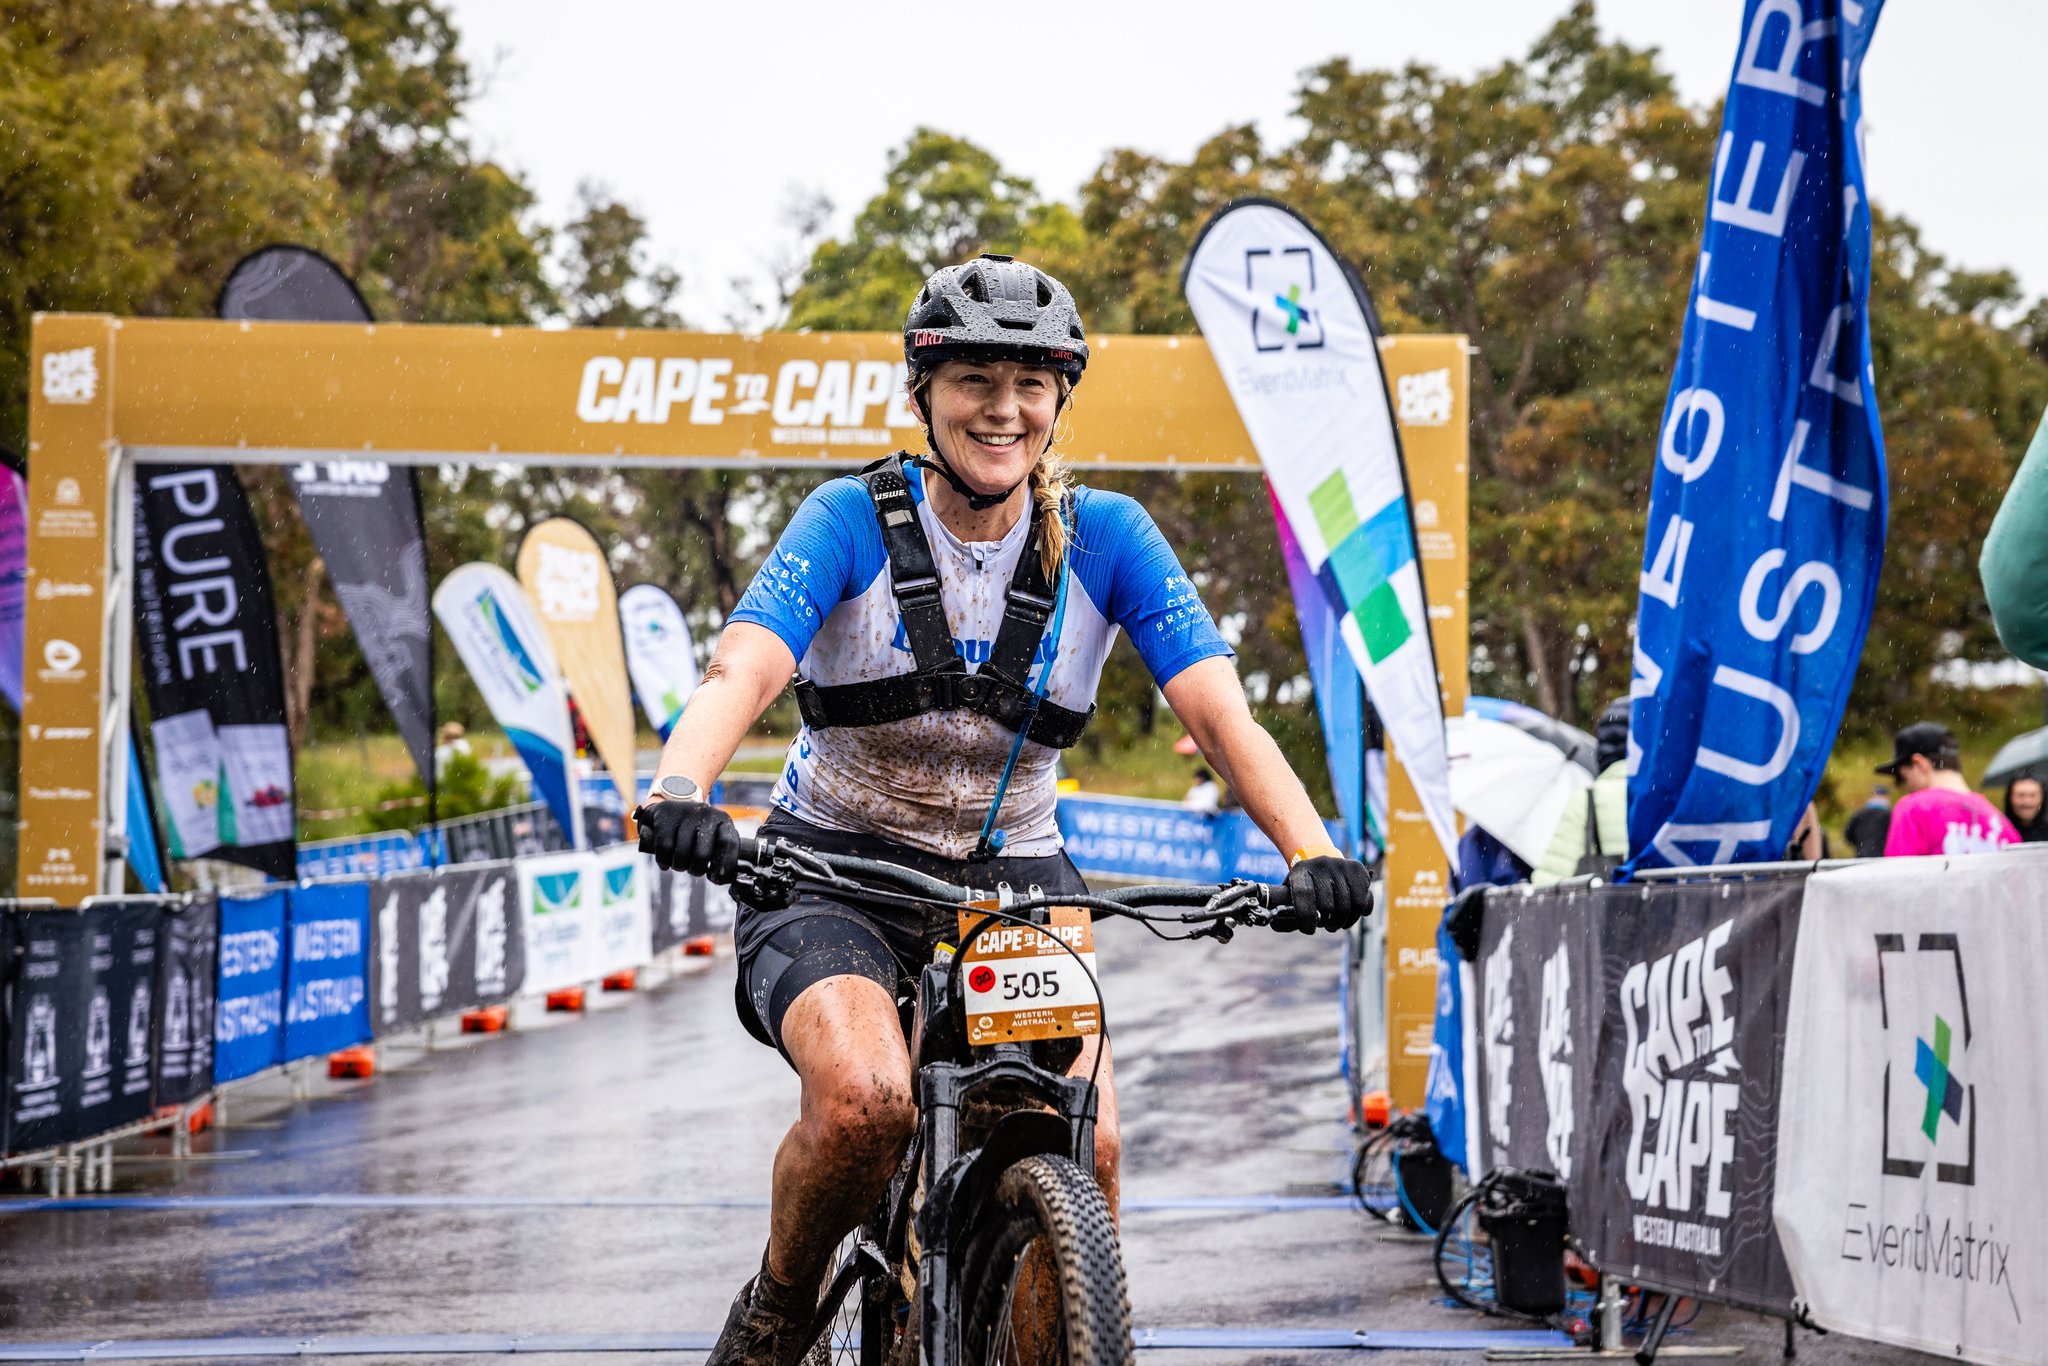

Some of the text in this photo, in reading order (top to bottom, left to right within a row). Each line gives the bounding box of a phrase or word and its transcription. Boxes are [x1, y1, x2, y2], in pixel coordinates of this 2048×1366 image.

[915, 332, 943, 347] GIRO
[1051, 350, 1073, 361] GIRO
[576, 356, 915, 428] CAPE TO CAPE
[150, 469, 248, 680] PURE
[1075, 810, 1214, 844] WESTERN
[1064, 835, 1222, 871] AUSTRALIA
[976, 926, 1083, 954] CAPE TO CAPE
[1003, 970, 1060, 1000] 505
[1620, 919, 1736, 1076] CAPE
[1012, 1017, 1057, 1027] AUSTRALIA
[1014, 1010, 1053, 1019] WESTERN
[1624, 1078, 1740, 1218] CAPE
[1633, 1214, 1722, 1256] WESTERN AUSTRALIA
[1841, 1202, 2022, 1324] EventMatrix
